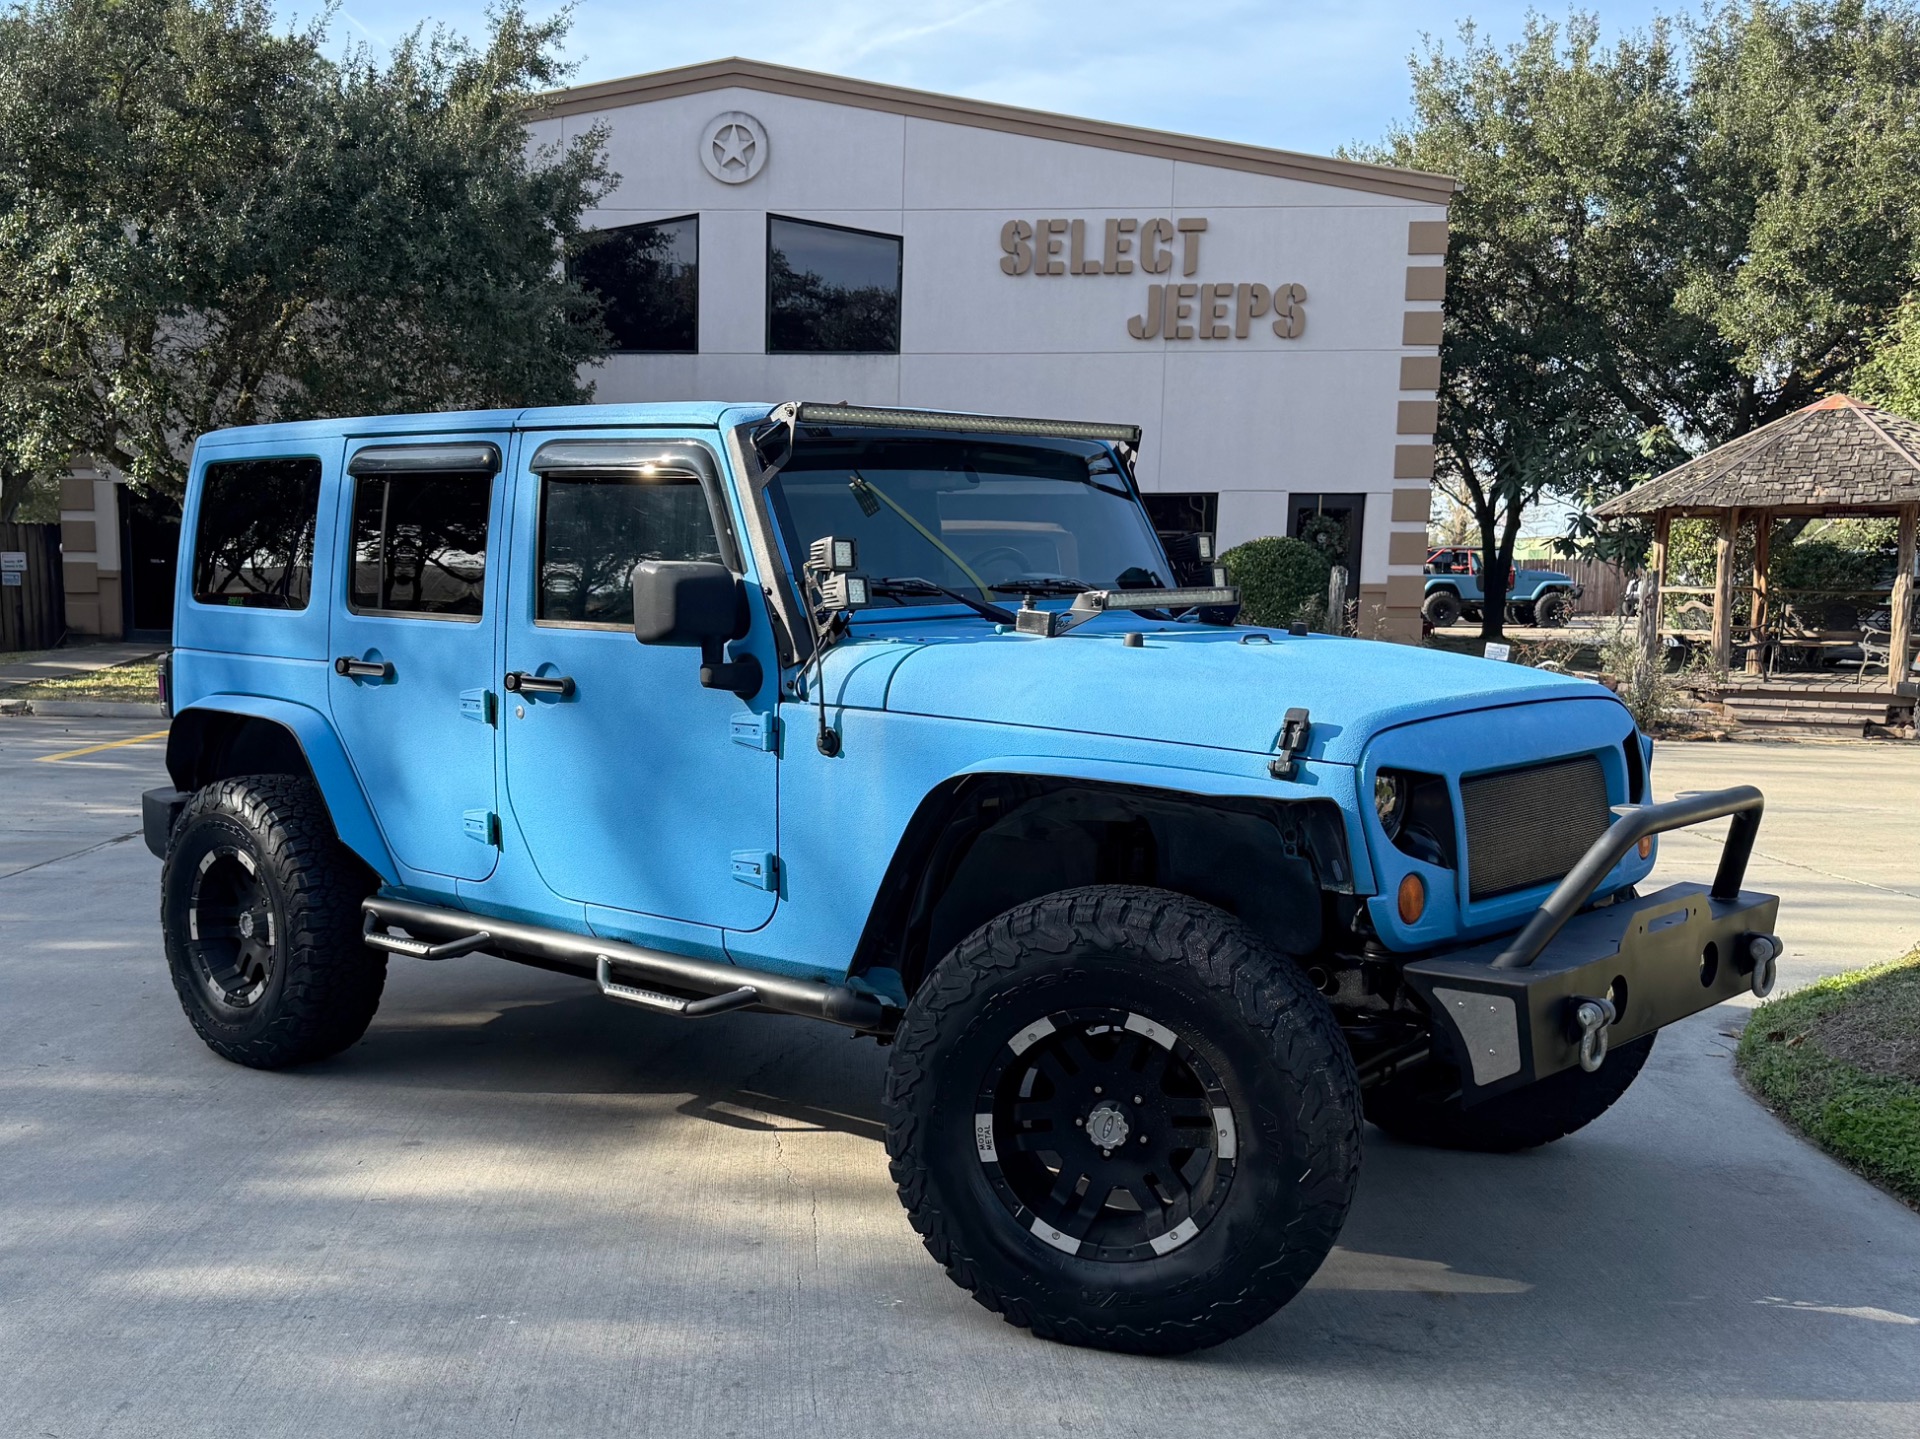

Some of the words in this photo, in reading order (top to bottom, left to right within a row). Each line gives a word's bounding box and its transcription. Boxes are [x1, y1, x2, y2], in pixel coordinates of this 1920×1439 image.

[1000, 218, 1208, 277] SELECT
[1127, 283, 1308, 340] JEEPS
[977, 1127, 986, 1150] MOTO
[984, 1125, 993, 1150] METAL
